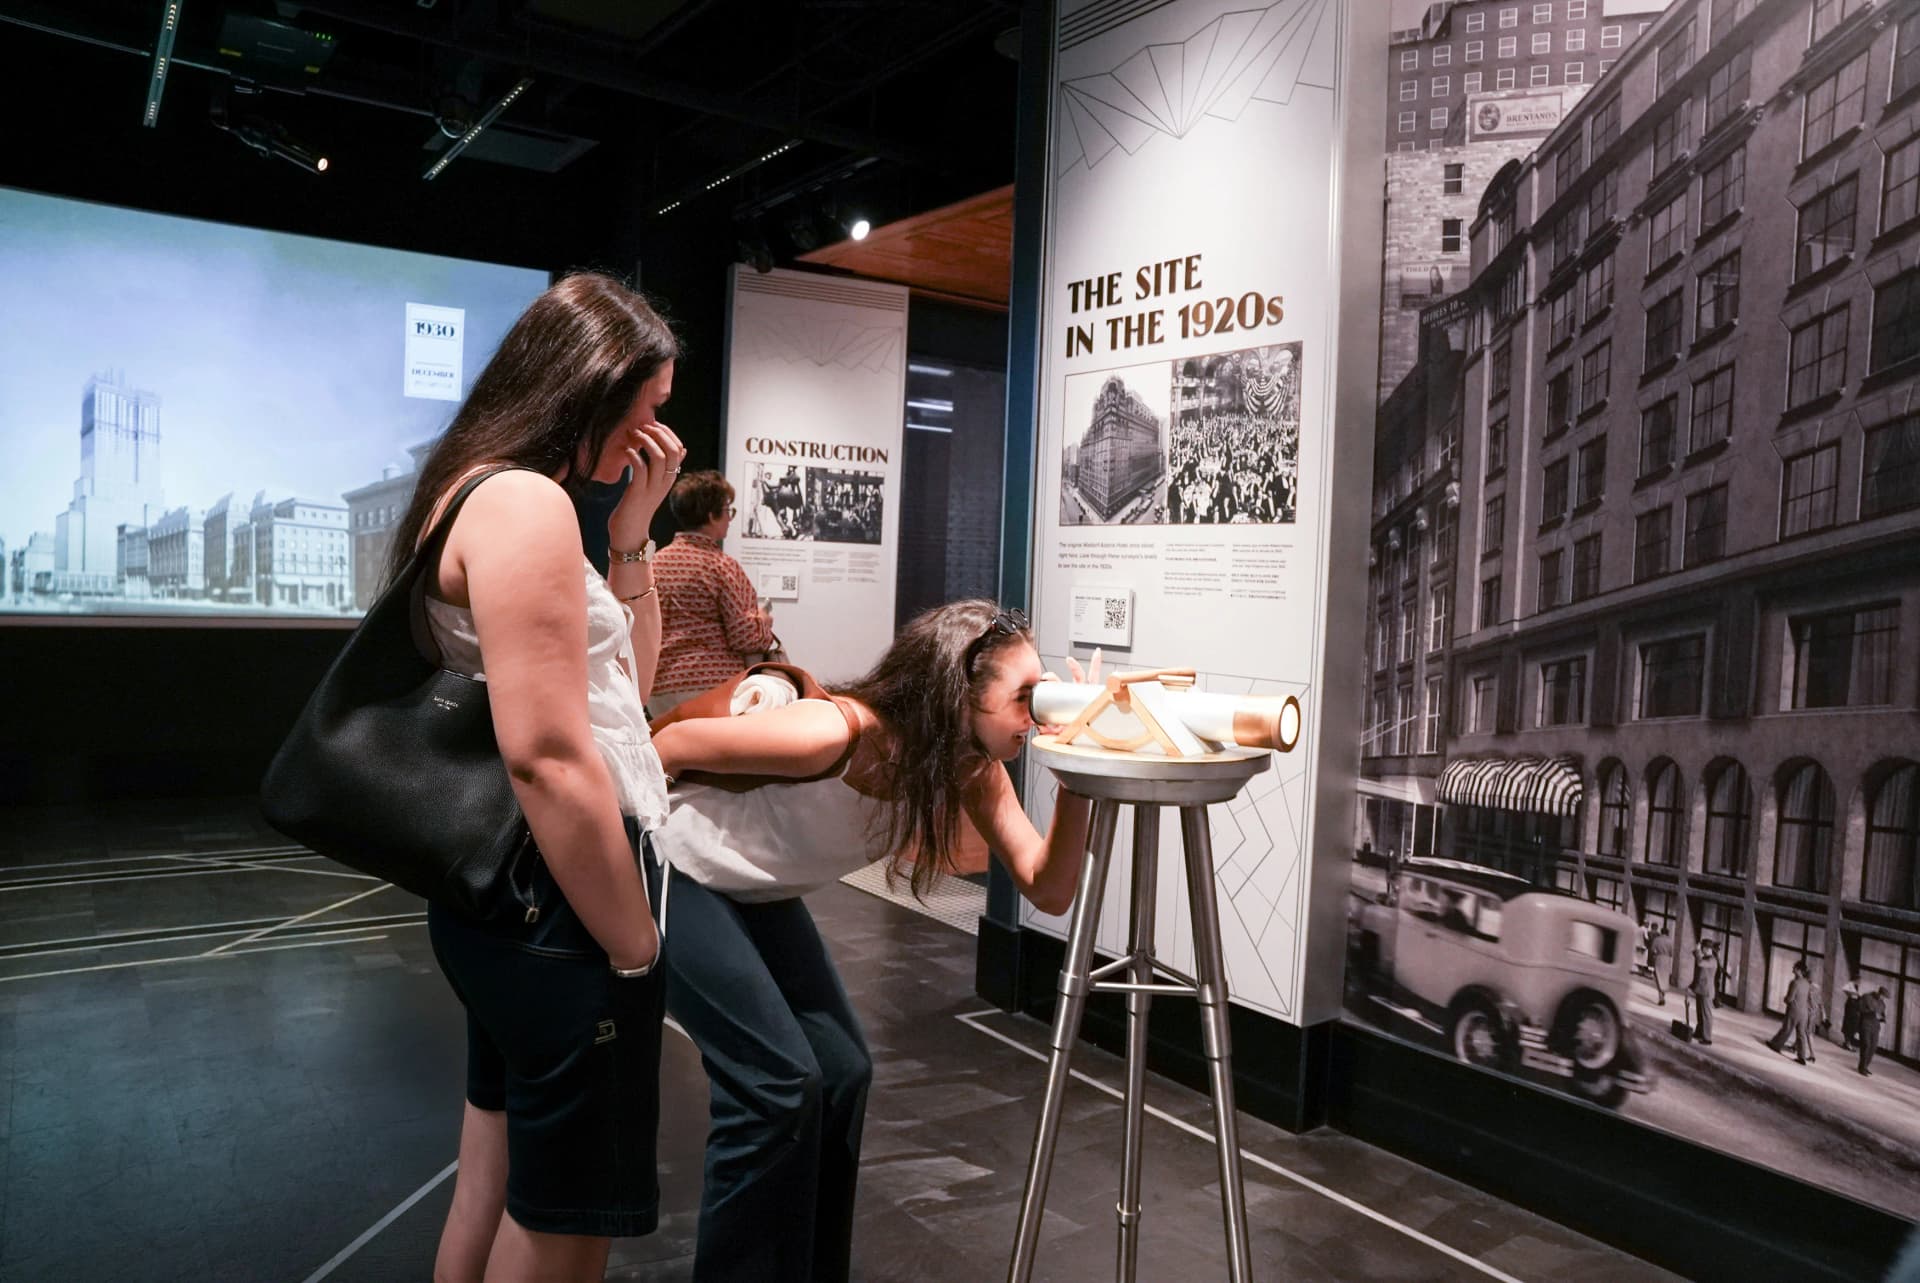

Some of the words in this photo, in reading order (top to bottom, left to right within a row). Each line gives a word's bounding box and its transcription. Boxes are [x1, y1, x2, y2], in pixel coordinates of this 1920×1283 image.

[1067, 271, 1122, 314] THE
[1135, 253, 1202, 301] SITE
[416, 321, 455, 337] 1930
[1066, 322, 1094, 358] IN
[1106, 309, 1164, 351] THE
[1178, 291, 1284, 339] 1920s
[411, 367, 454, 378] DECEMBER
[745, 437, 889, 465] CONSTRUCTION
